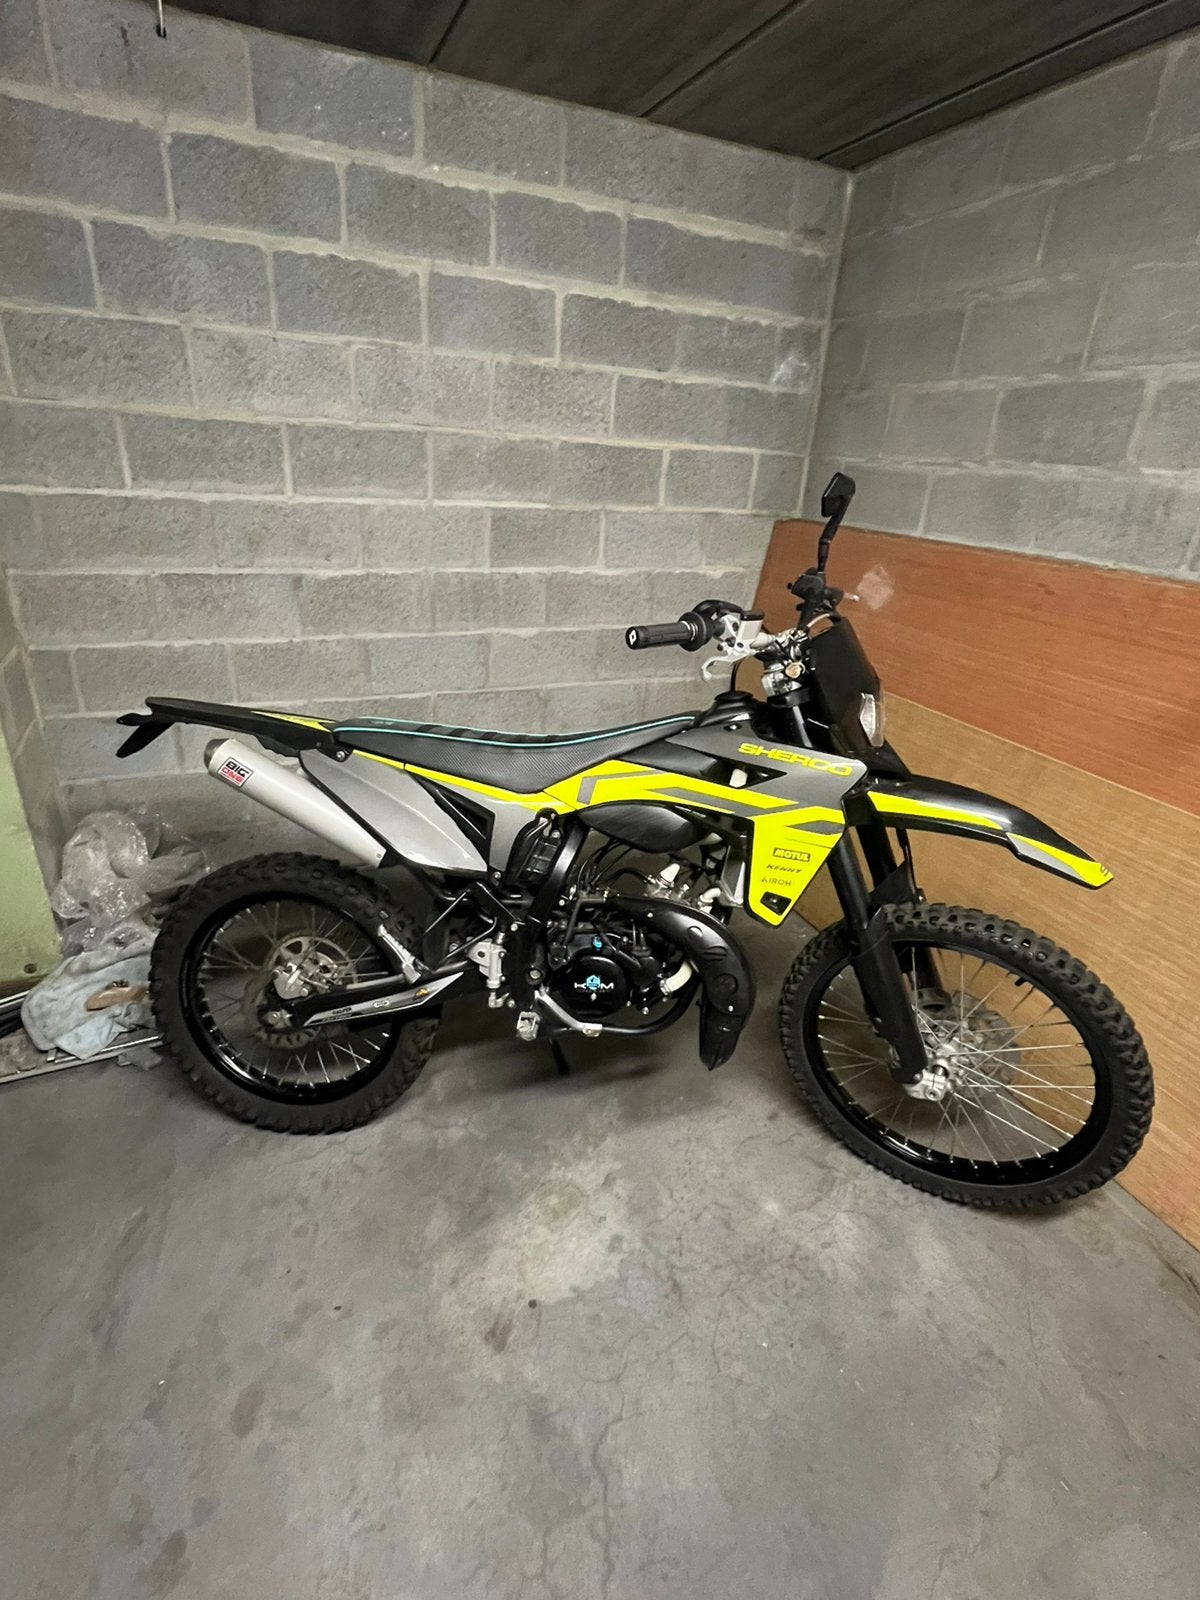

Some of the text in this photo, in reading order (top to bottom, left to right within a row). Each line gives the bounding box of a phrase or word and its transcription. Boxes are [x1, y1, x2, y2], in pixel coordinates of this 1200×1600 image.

[225, 760, 250, 778] BIG
[773, 848, 810, 862] MOTUL
[766, 864, 802, 874] KENNY
